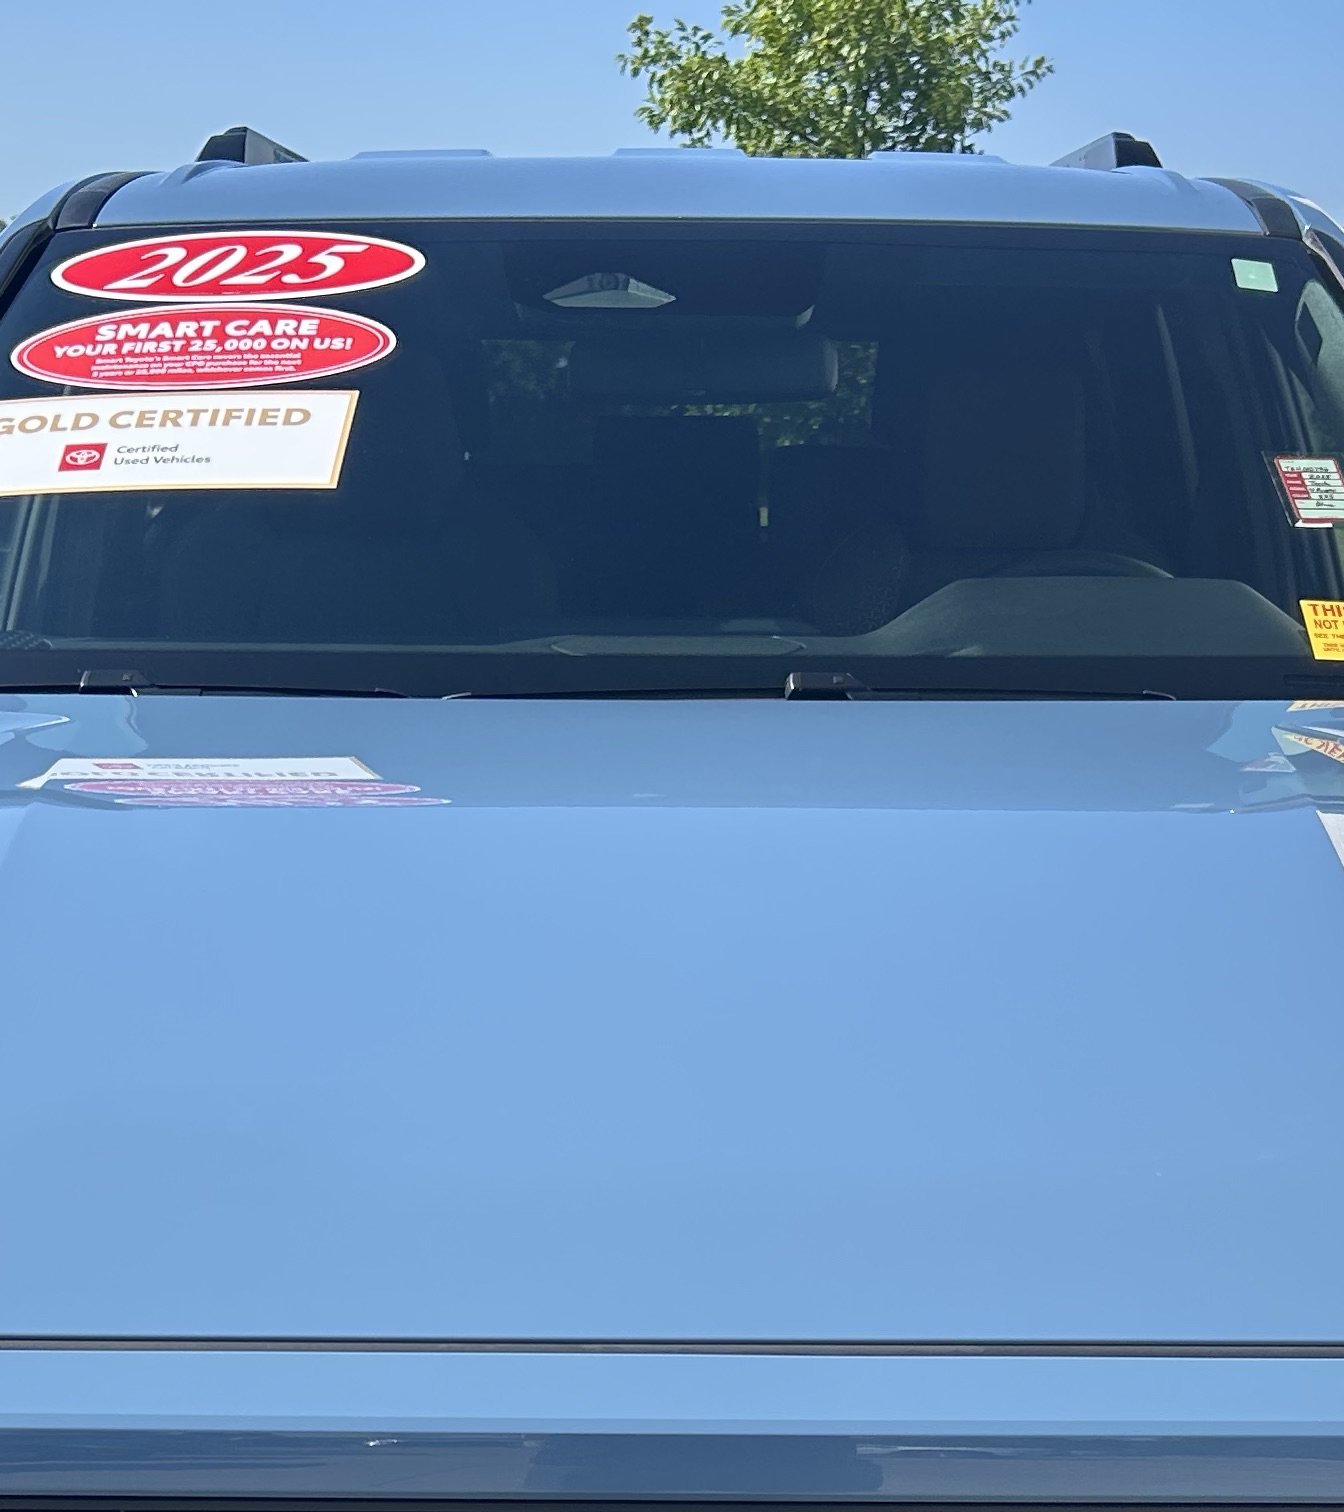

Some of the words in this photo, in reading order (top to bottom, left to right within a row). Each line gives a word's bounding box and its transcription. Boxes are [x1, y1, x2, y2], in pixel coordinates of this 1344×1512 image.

[103, 243, 371, 290] 2025
[95, 319, 221, 341] SMART
[224, 318, 320, 336] CARE
[54, 343, 118, 358] YOUR
[121, 340, 187, 354] FIRST
[188, 337, 267, 353] 25,000
[270, 337, 309, 351] ON
[313, 337, 354, 351] US!
[108, 407, 312, 429] CERTIFIED
[117, 444, 179, 454] Certified
[114, 456, 149, 465] Used
[154, 455, 211, 464] Vehicles
[1313, 619, 1339, 631] NOT
